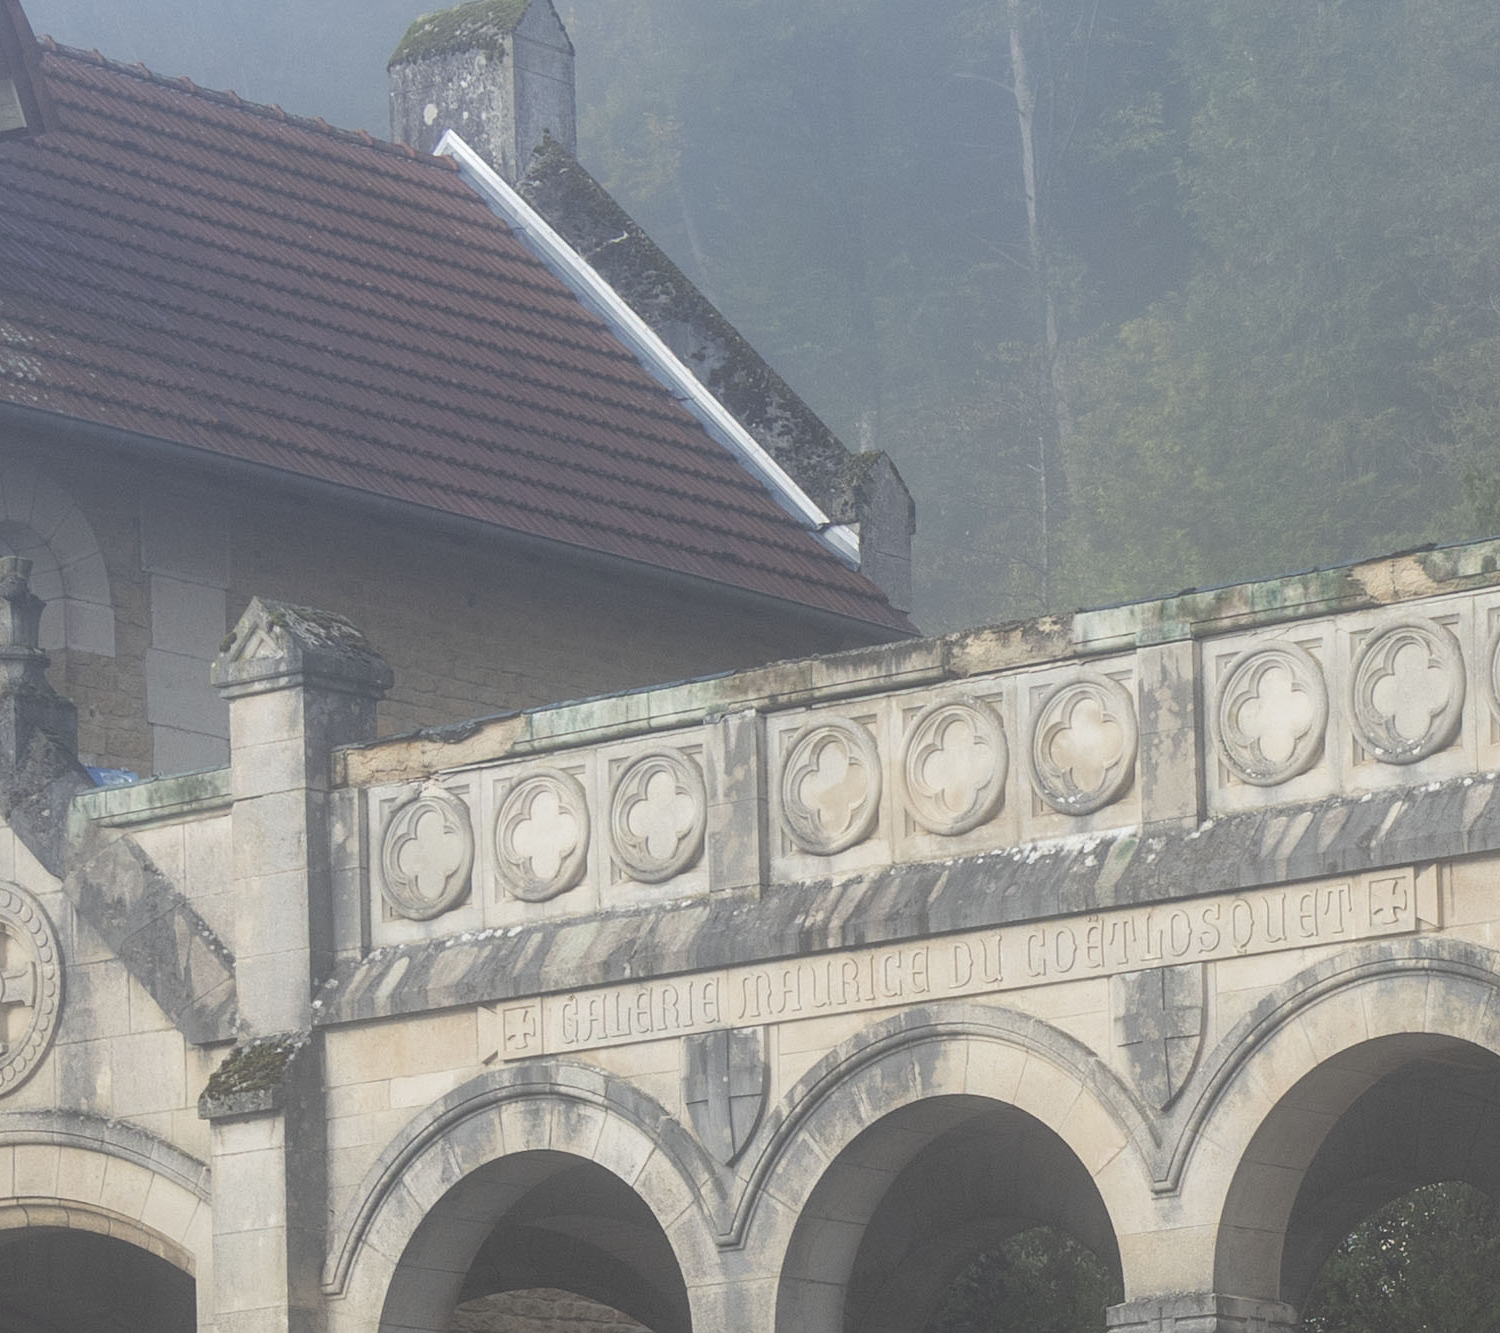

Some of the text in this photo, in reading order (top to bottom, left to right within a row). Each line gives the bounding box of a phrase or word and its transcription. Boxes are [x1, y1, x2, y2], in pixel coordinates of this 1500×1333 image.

[561, 976, 721, 1044] GALERIE
[737, 943, 931, 1018] MAURICE
[948, 934, 1004, 990] DU
